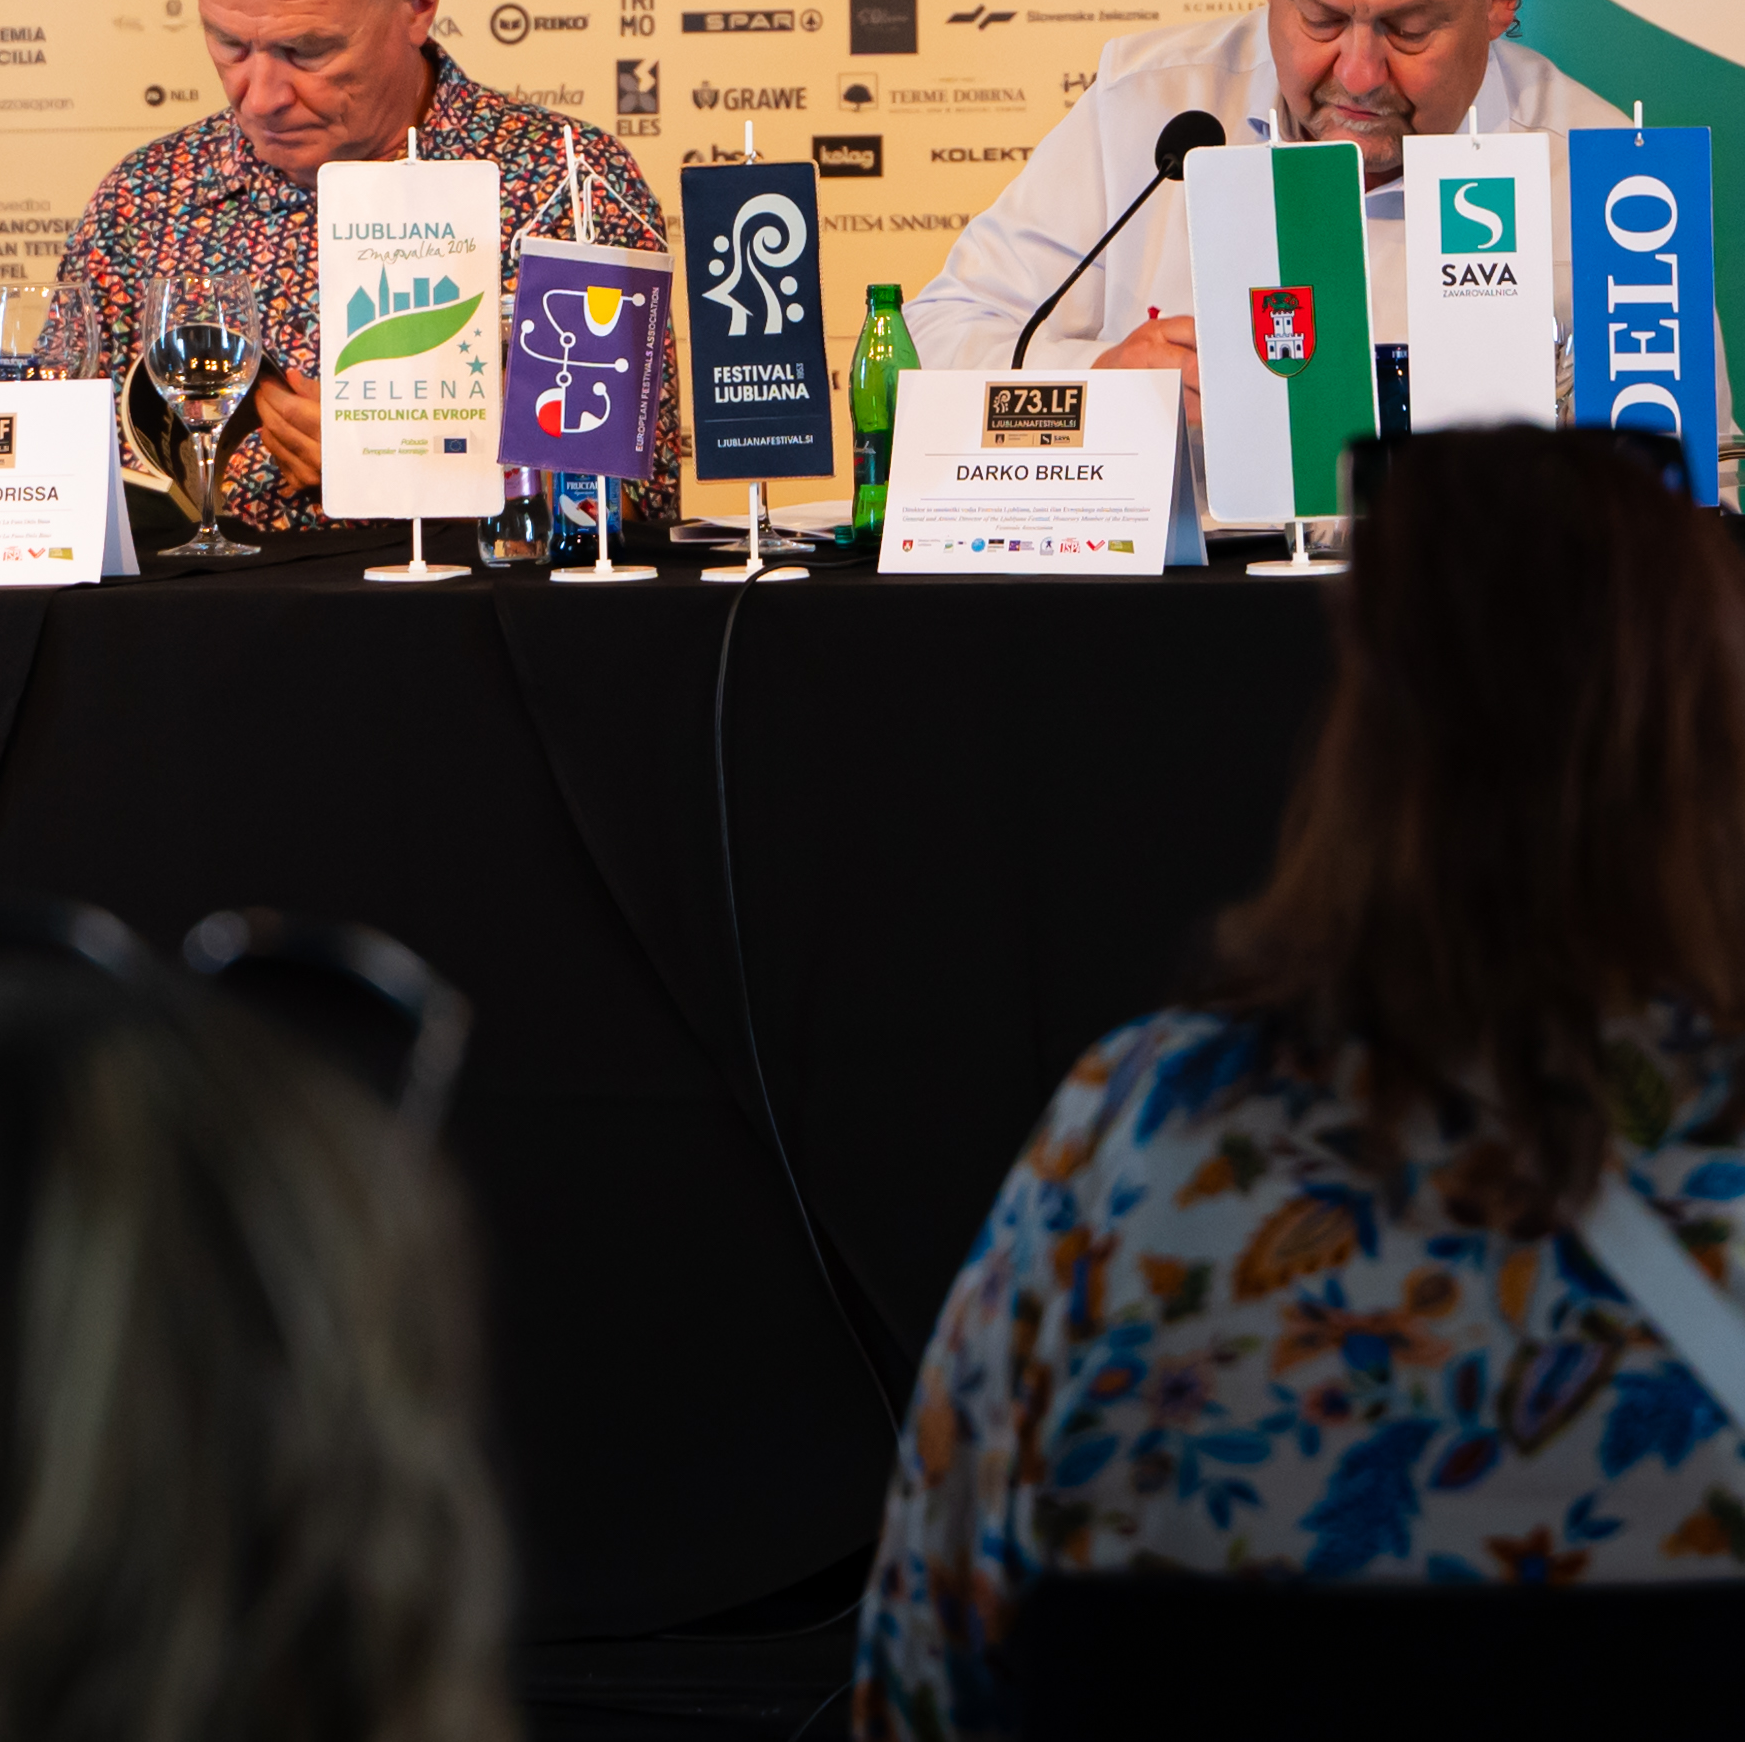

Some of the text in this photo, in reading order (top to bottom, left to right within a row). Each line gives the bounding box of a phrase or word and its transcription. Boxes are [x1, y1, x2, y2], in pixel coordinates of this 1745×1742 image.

[534, 15, 588, 30] RIKO
[620, 15, 655, 37] MO
[706, 11, 793, 30] SPAR
[724, 87, 807, 111] GRAWE
[889, 88, 1026, 104] TERME DOBRNA
[617, 118, 660, 136] ELES
[332, 222, 455, 240] LJUBLJANA
[448, 238, 476, 255] 2016
[1442, 263, 1518, 286] SAVA
[1443, 288, 1518, 298] ZAVAROVALNICA
[1605, 175, 1682, 439] DELO
[635, 287, 660, 452] EUROPEAN FESTIVALS ASSOCIATION
[713, 364, 794, 383] FESTIVAL
[335, 381, 485, 399] ZELENA
[715, 383, 810, 403] LJUBLJANA
[335, 409, 486, 421] PRESTOLNICA EVROPE
[718, 435, 813, 448] LJUBLJANAFESTIVAL.SI
[957, 465, 1104, 481] DARKO BRLEK
